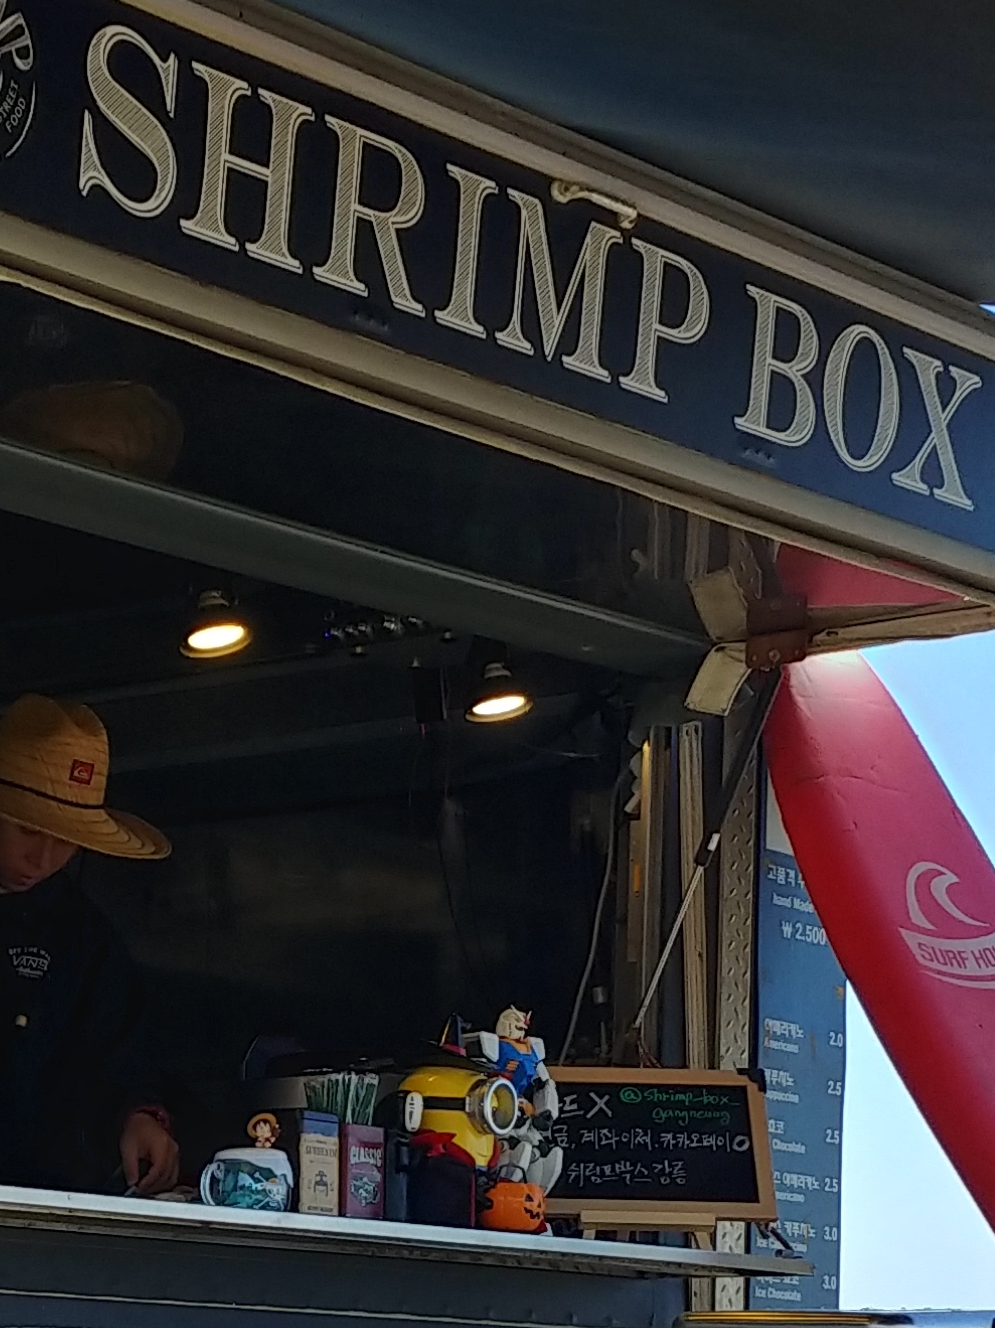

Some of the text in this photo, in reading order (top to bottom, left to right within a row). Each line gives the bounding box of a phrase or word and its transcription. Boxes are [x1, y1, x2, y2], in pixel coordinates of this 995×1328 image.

[4, 98, 27, 133] FOOD
[77, 23, 984, 511] SHRIMP BOX
[12, 954, 49, 972] VANS
[917, 942, 995, 970] SURF HO
[829, 1031, 844, 1048] 2.0
[827, 1080, 843, 1096] 2.5
[825, 1128, 840, 1145] 2.5
[824, 1177, 839, 1193] 2.5
[823, 1226, 838, 1242] 3.0
[822, 1274, 837, 1291] 3.0
